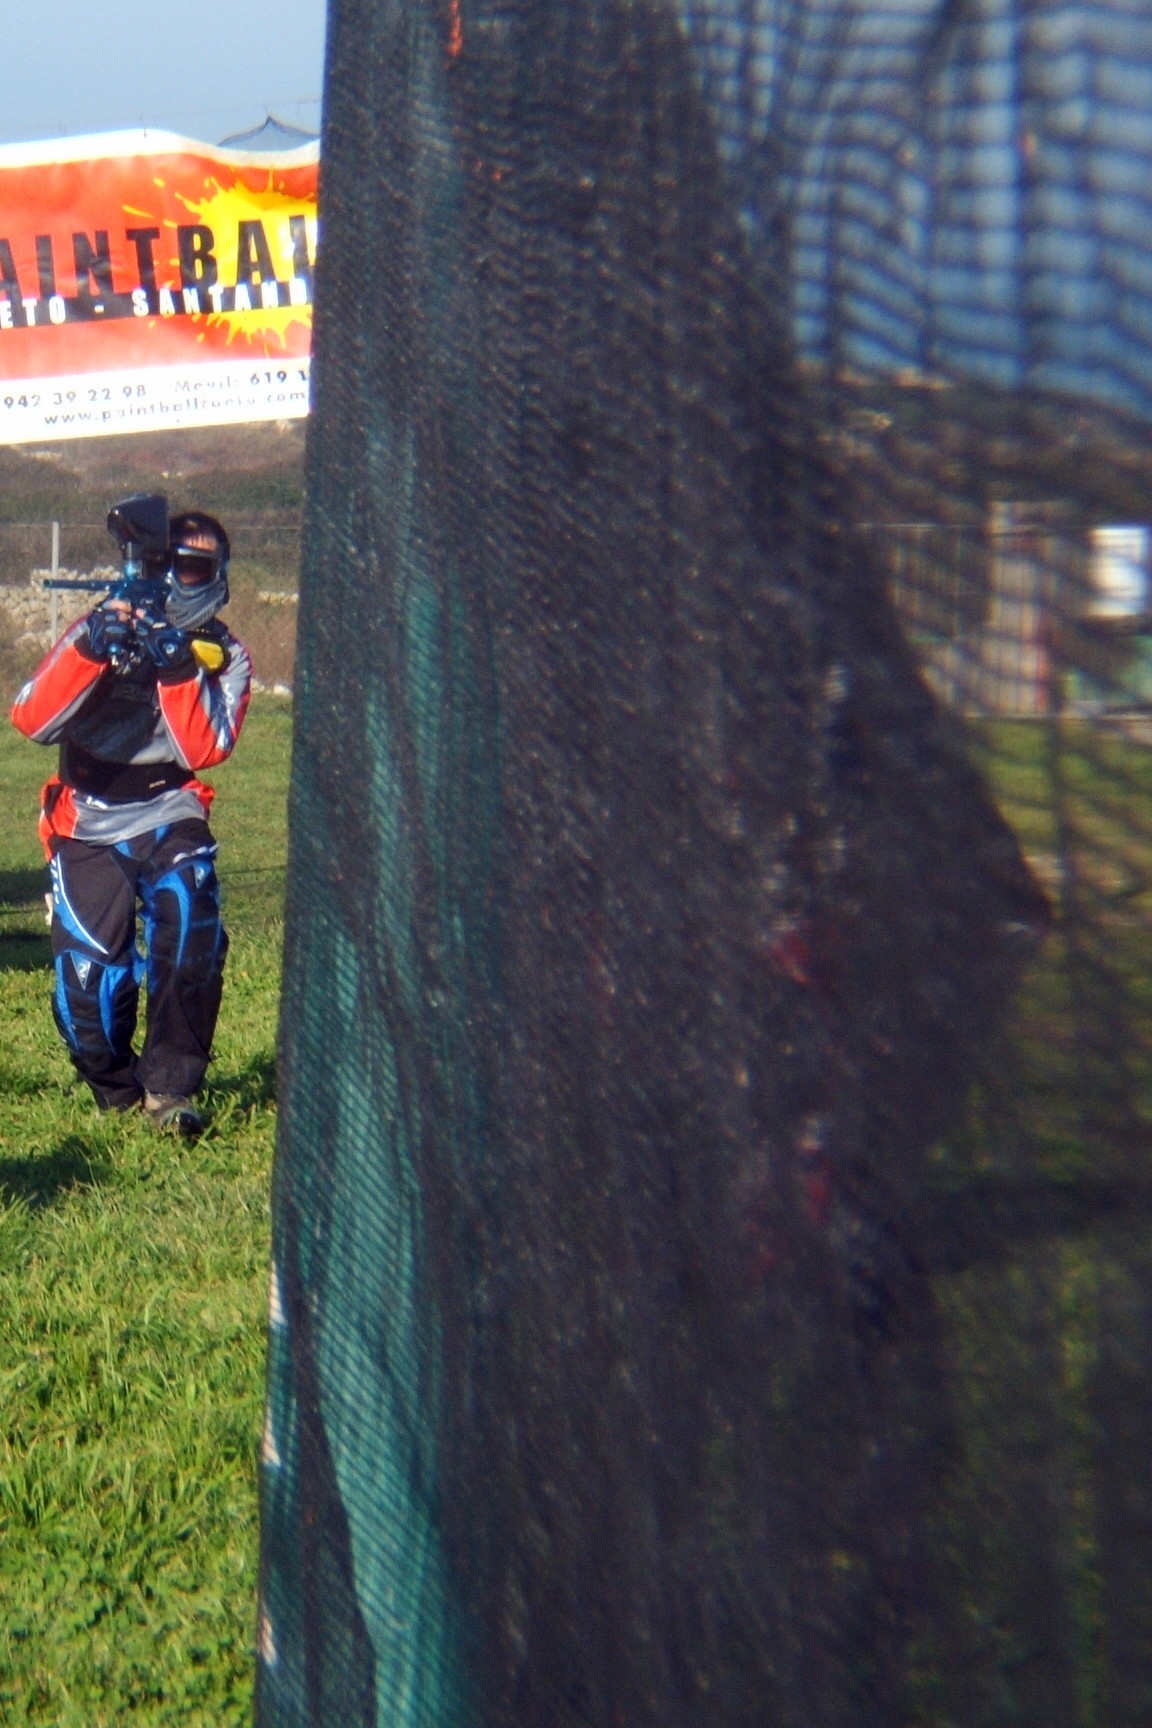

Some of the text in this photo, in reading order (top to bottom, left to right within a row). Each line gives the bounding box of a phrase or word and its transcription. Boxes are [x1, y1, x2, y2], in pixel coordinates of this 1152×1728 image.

[131, 278, 308, 317] SANTAND
[3, 394, 41, 409] 942
[53, 391, 77, 405] 39
[88, 388, 112, 402] 22
[122, 384, 146, 399] 98
[250, 370, 287, 385] 619
